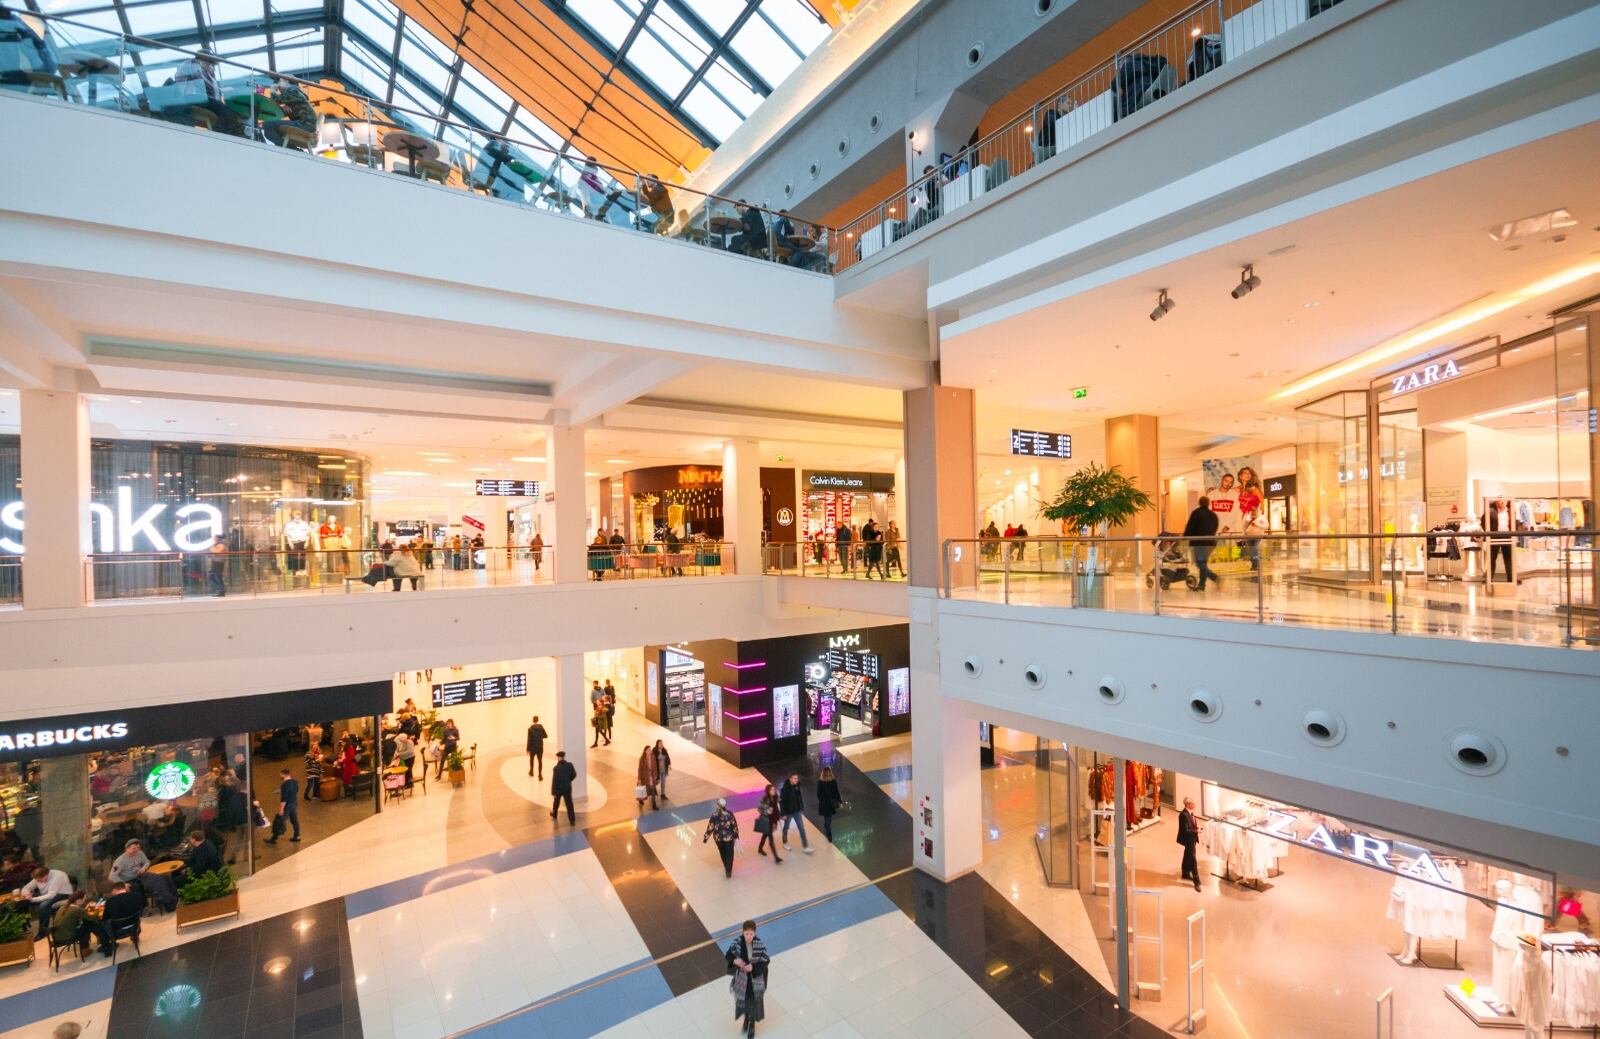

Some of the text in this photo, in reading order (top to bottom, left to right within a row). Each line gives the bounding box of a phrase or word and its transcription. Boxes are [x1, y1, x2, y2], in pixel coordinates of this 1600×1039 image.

[1392, 359, 1460, 395] ZARA
[1013, 435, 1019, 446] 2
[810, 475, 863, 486] Calvin Klein Jeans
[829, 634, 860, 648] NYX
[433, 689, 442, 700] 1
[0, 722, 129, 751] ARBUCKS
[1267, 810, 1452, 885] ZARA
